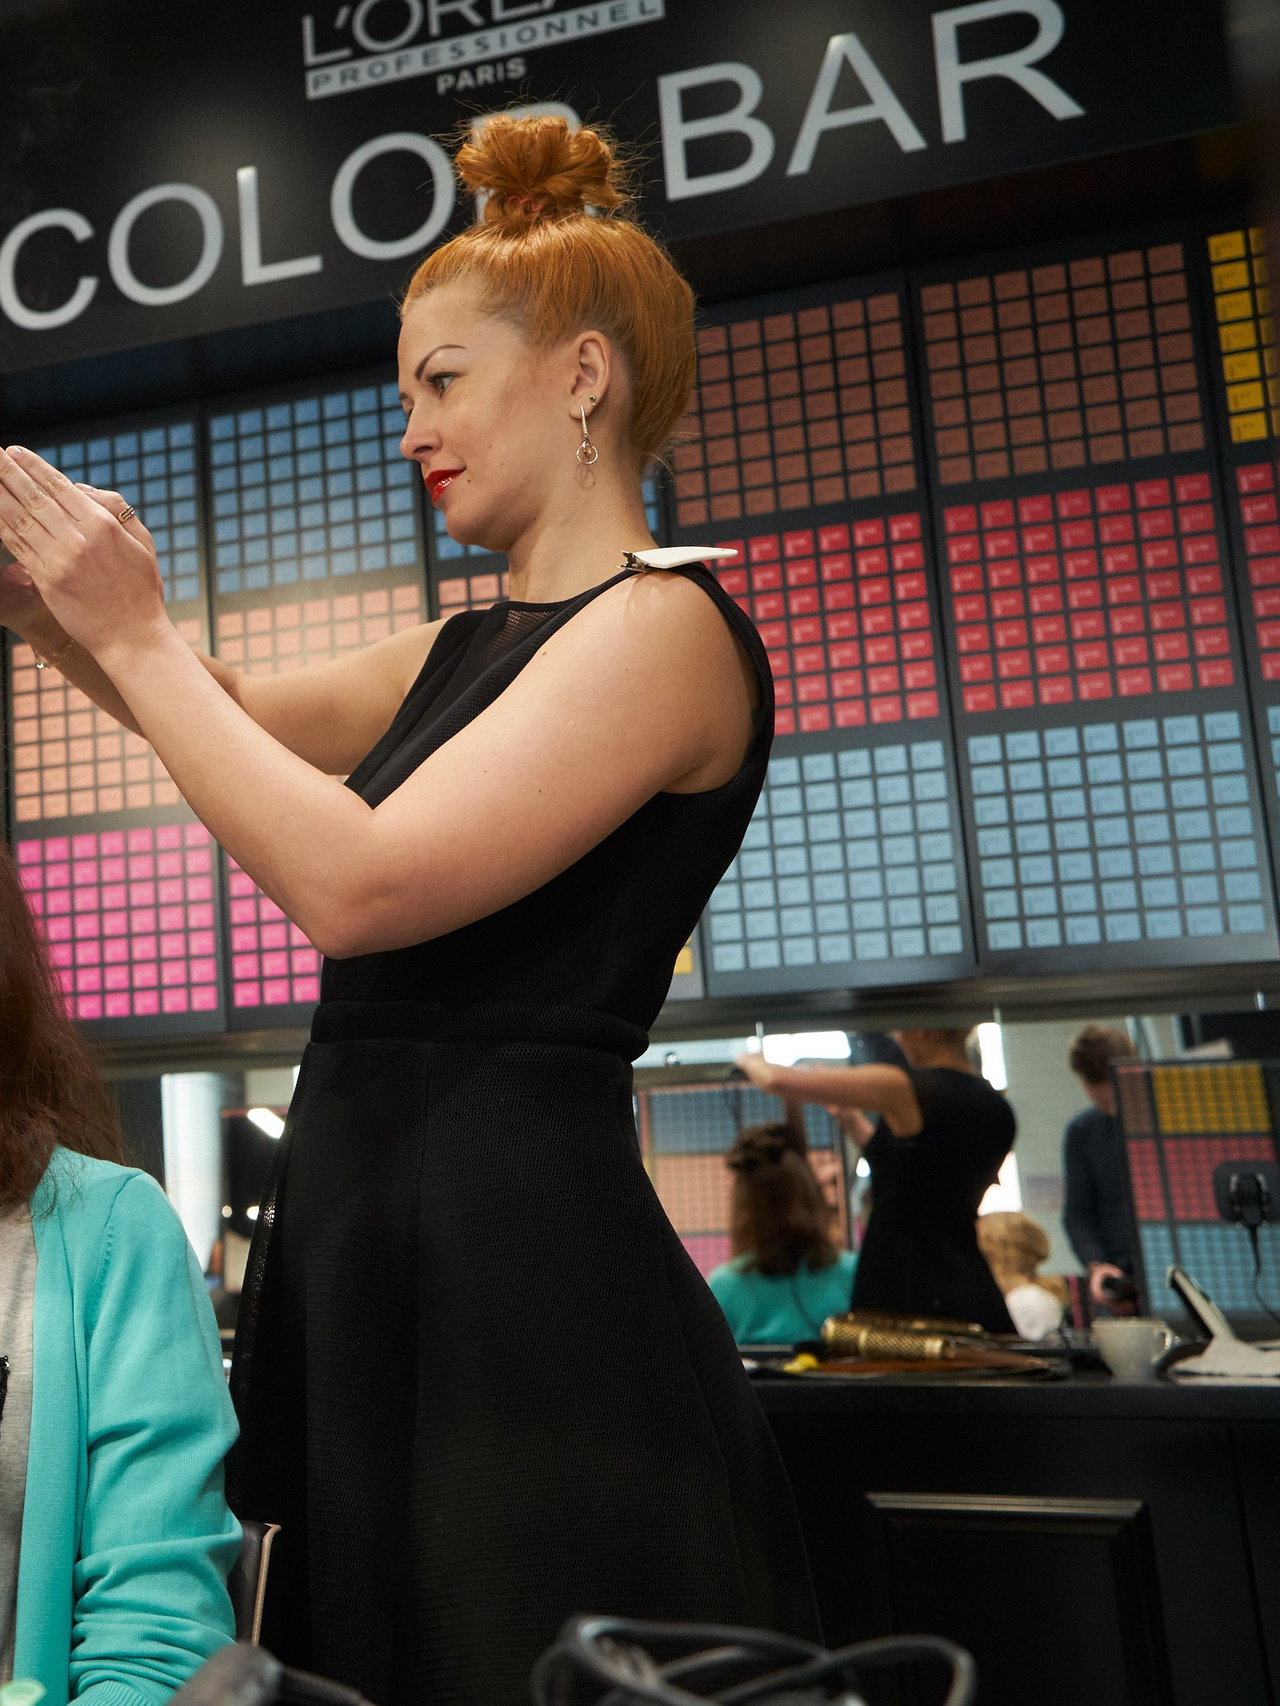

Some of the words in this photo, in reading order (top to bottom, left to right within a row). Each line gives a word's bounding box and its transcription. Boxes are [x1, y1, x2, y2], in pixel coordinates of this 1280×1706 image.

[310, 2, 659, 93] PROFESSIONNEL
[437, 58, 527, 95] PARIS
[657, 0, 1086, 201] BAR
